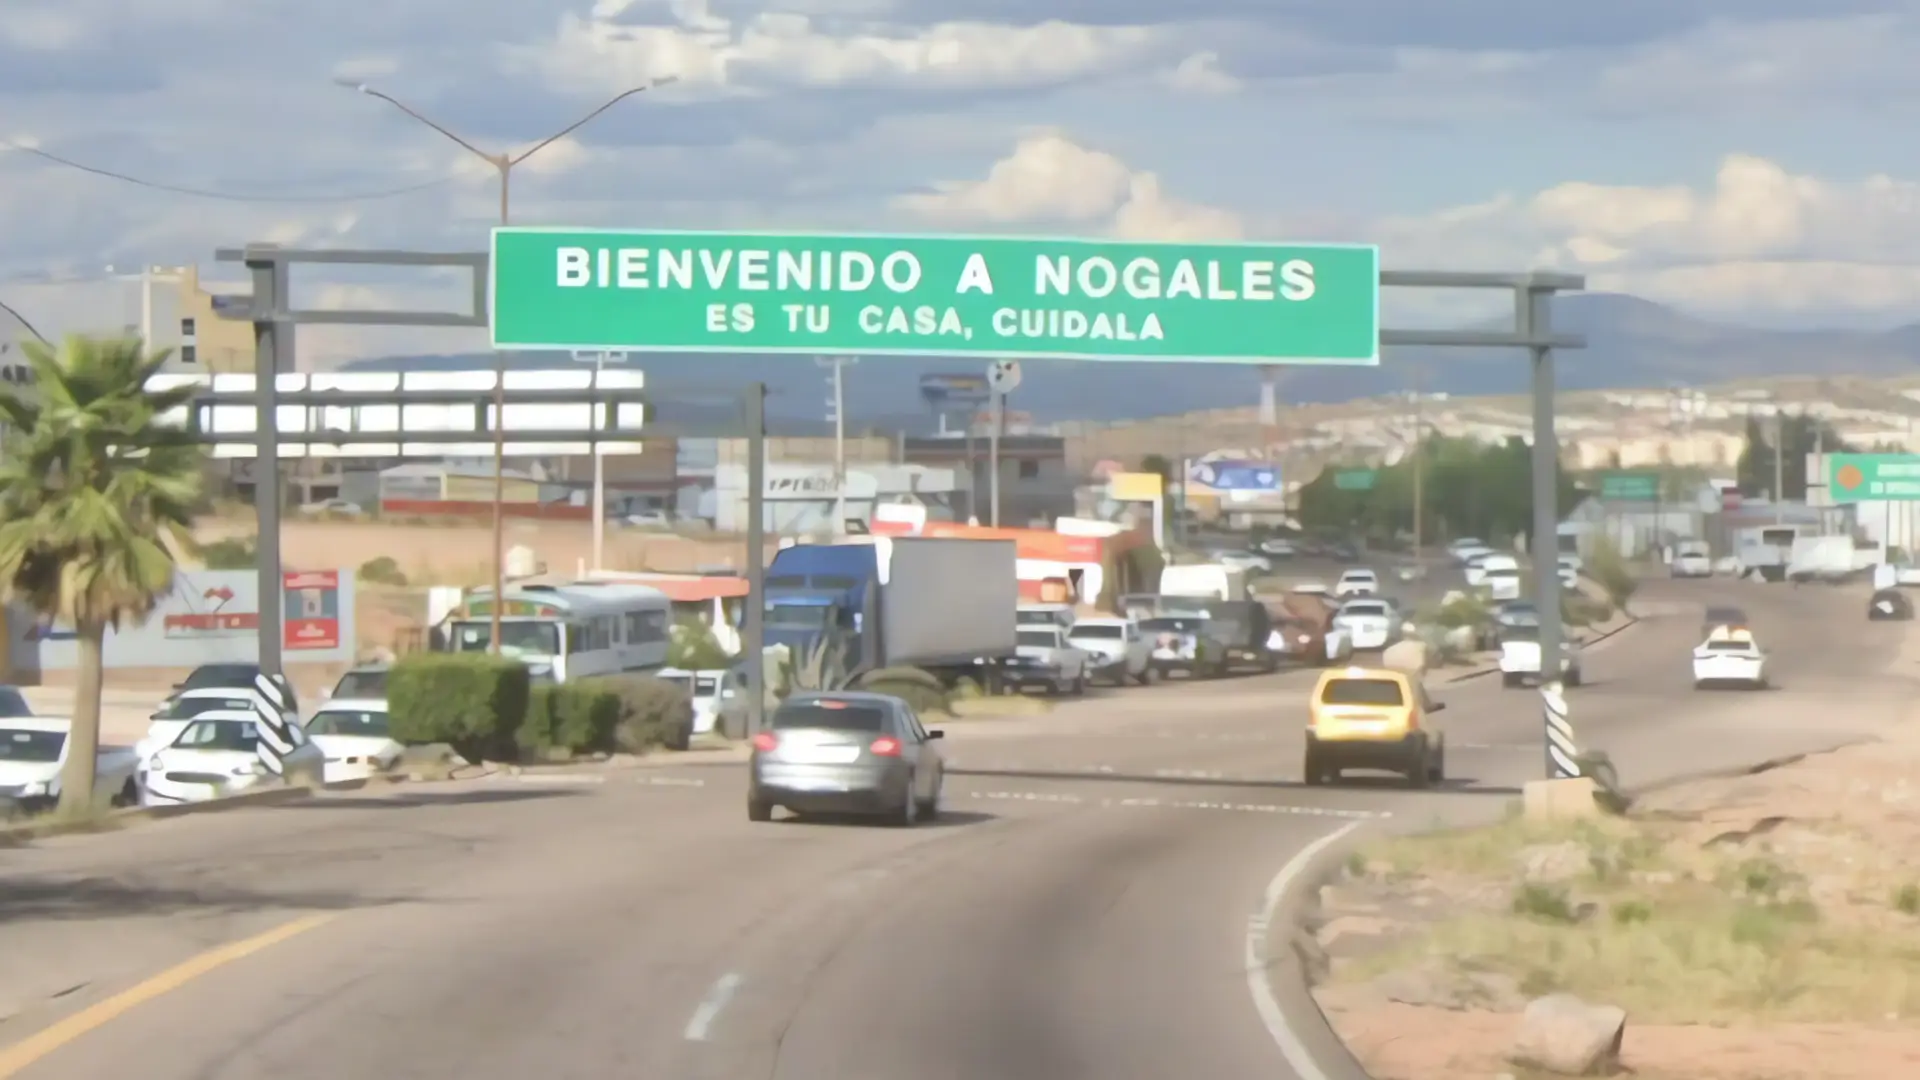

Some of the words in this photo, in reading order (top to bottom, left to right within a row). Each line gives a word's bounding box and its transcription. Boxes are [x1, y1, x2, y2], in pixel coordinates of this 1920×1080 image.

[556, 246, 922, 294] BIENVENIDO
[956, 252, 994, 295] A
[1035, 254, 1317, 302] NOGALES
[706, 303, 755, 333] ES
[782, 304, 830, 333] TU
[858, 304, 973, 340] CASA,
[992, 307, 1165, 341] CUIDALA
